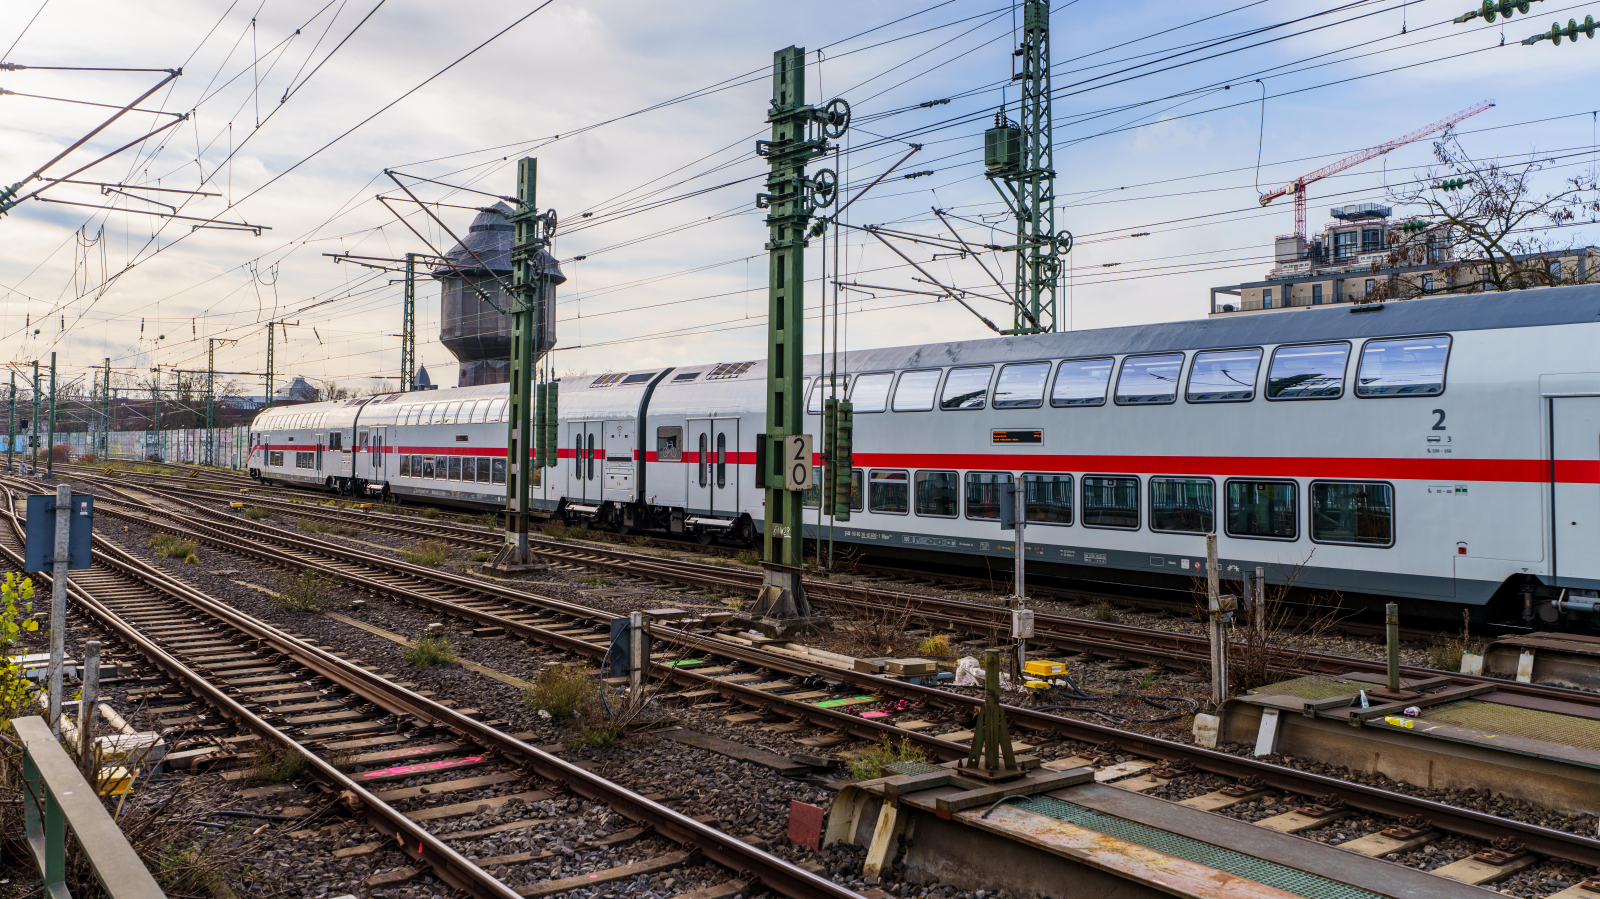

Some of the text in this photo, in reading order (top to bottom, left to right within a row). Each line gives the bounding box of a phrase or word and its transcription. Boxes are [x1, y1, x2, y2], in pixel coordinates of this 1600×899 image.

[1431, 408, 1446, 431] 2
[793, 437, 805, 461] 2
[1446, 435, 1452, 443] 3
[792, 462, 807, 486] 0
